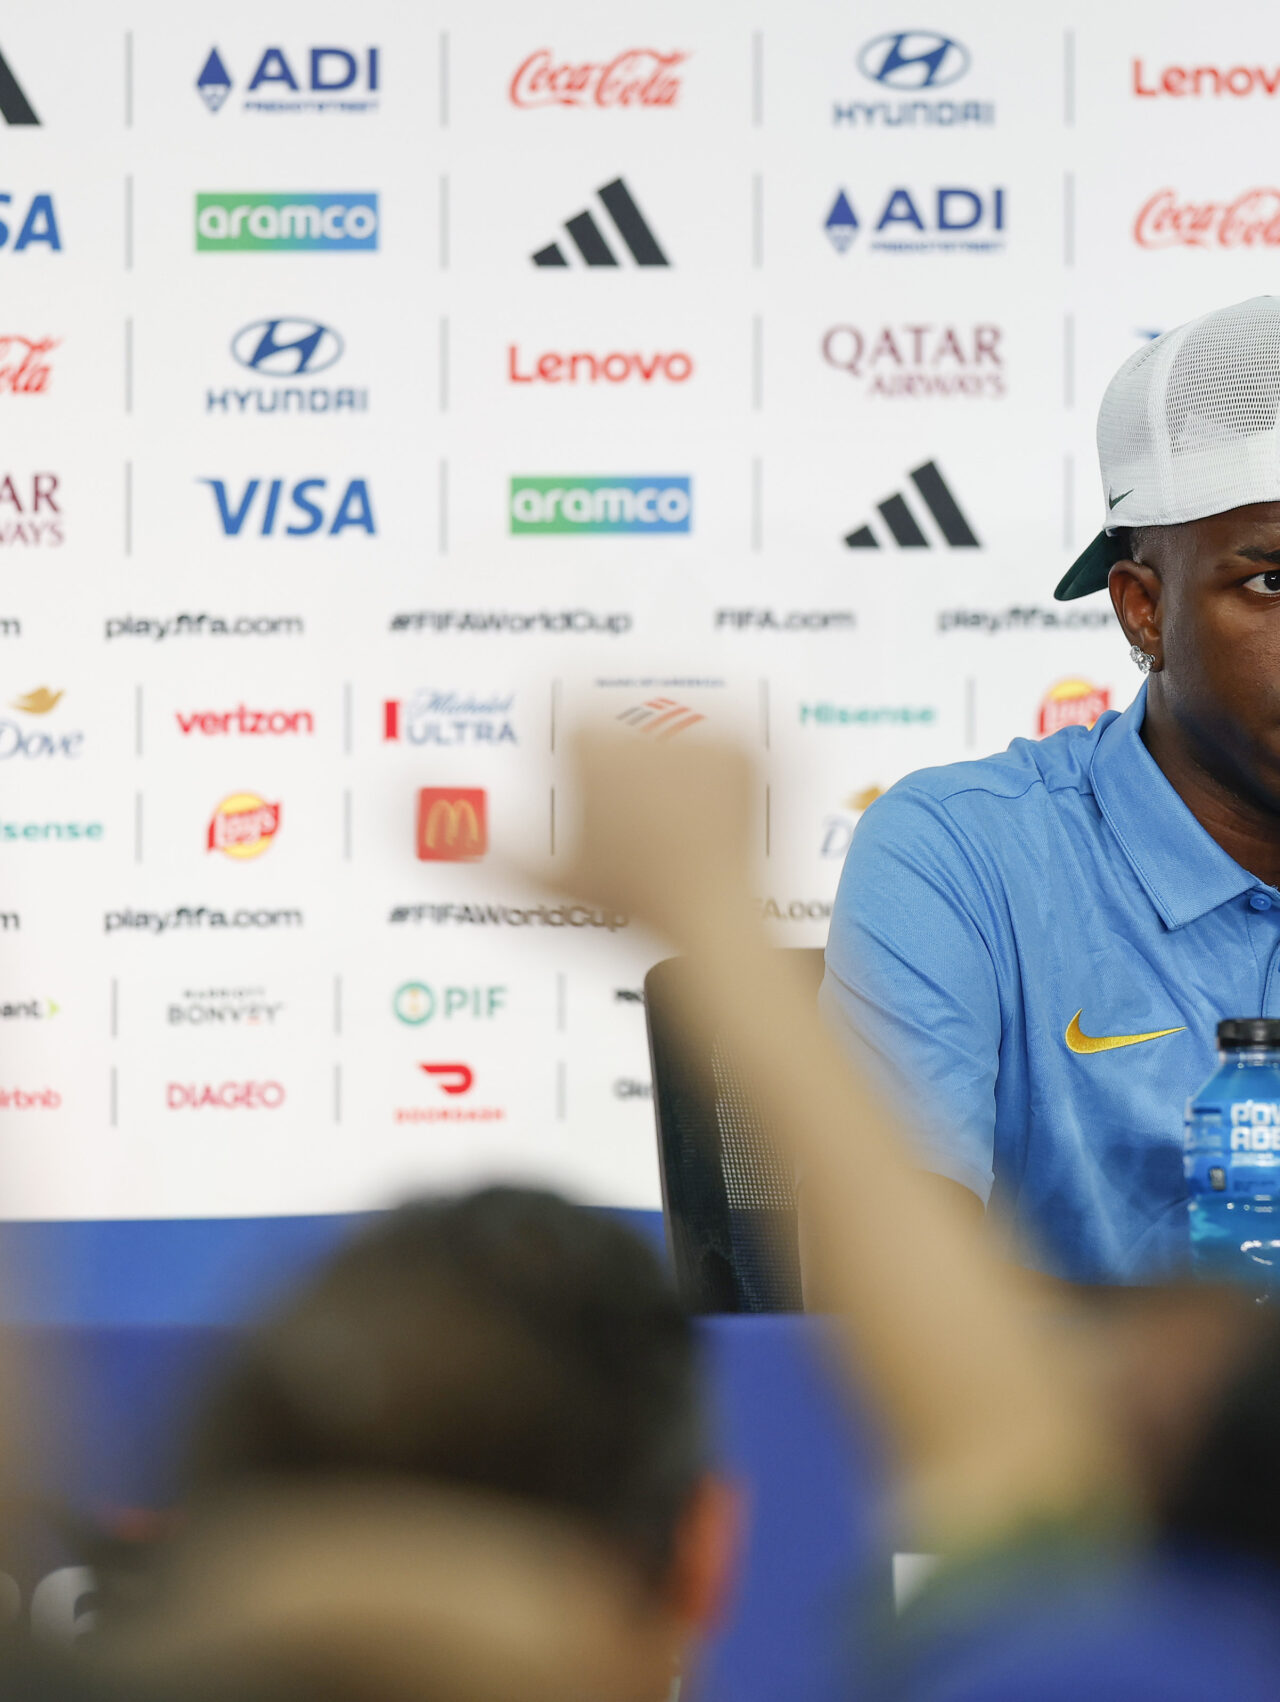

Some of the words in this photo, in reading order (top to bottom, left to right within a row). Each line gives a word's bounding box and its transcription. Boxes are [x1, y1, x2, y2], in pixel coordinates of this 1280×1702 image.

[248, 47, 379, 92] ADI
[508, 49, 690, 109] Coca-Cola
[833, 100, 994, 127] HYUNDAI
[199, 205, 376, 239] aramco
[875, 188, 1004, 232] ADI
[508, 345, 693, 384] Lenovo
[821, 324, 1004, 376] QATAR
[206, 388, 367, 413] HYUNDAI
[869, 376, 1006, 399] AIRWAYS
[198, 478, 377, 538] VISA
[513, 488, 689, 523] aramco
[105, 613, 303, 641] play.fifa.com
[389, 610, 632, 635] #FIFAWorldCup
[714, 608, 856, 631] FIFA.com
[938, 606, 1116, 633] play.fifa.co
[176, 704, 314, 735] verizon
[800, 703, 936, 725] Hisense
[0, 719, 85, 759] Dove
[407, 720, 518, 745] ULTRA
[0, 822, 104, 842] sense
[104, 906, 302, 934] play.fifa.com
[444, 986, 507, 1019] PIF
[167, 1081, 285, 1110] DIAGEO
